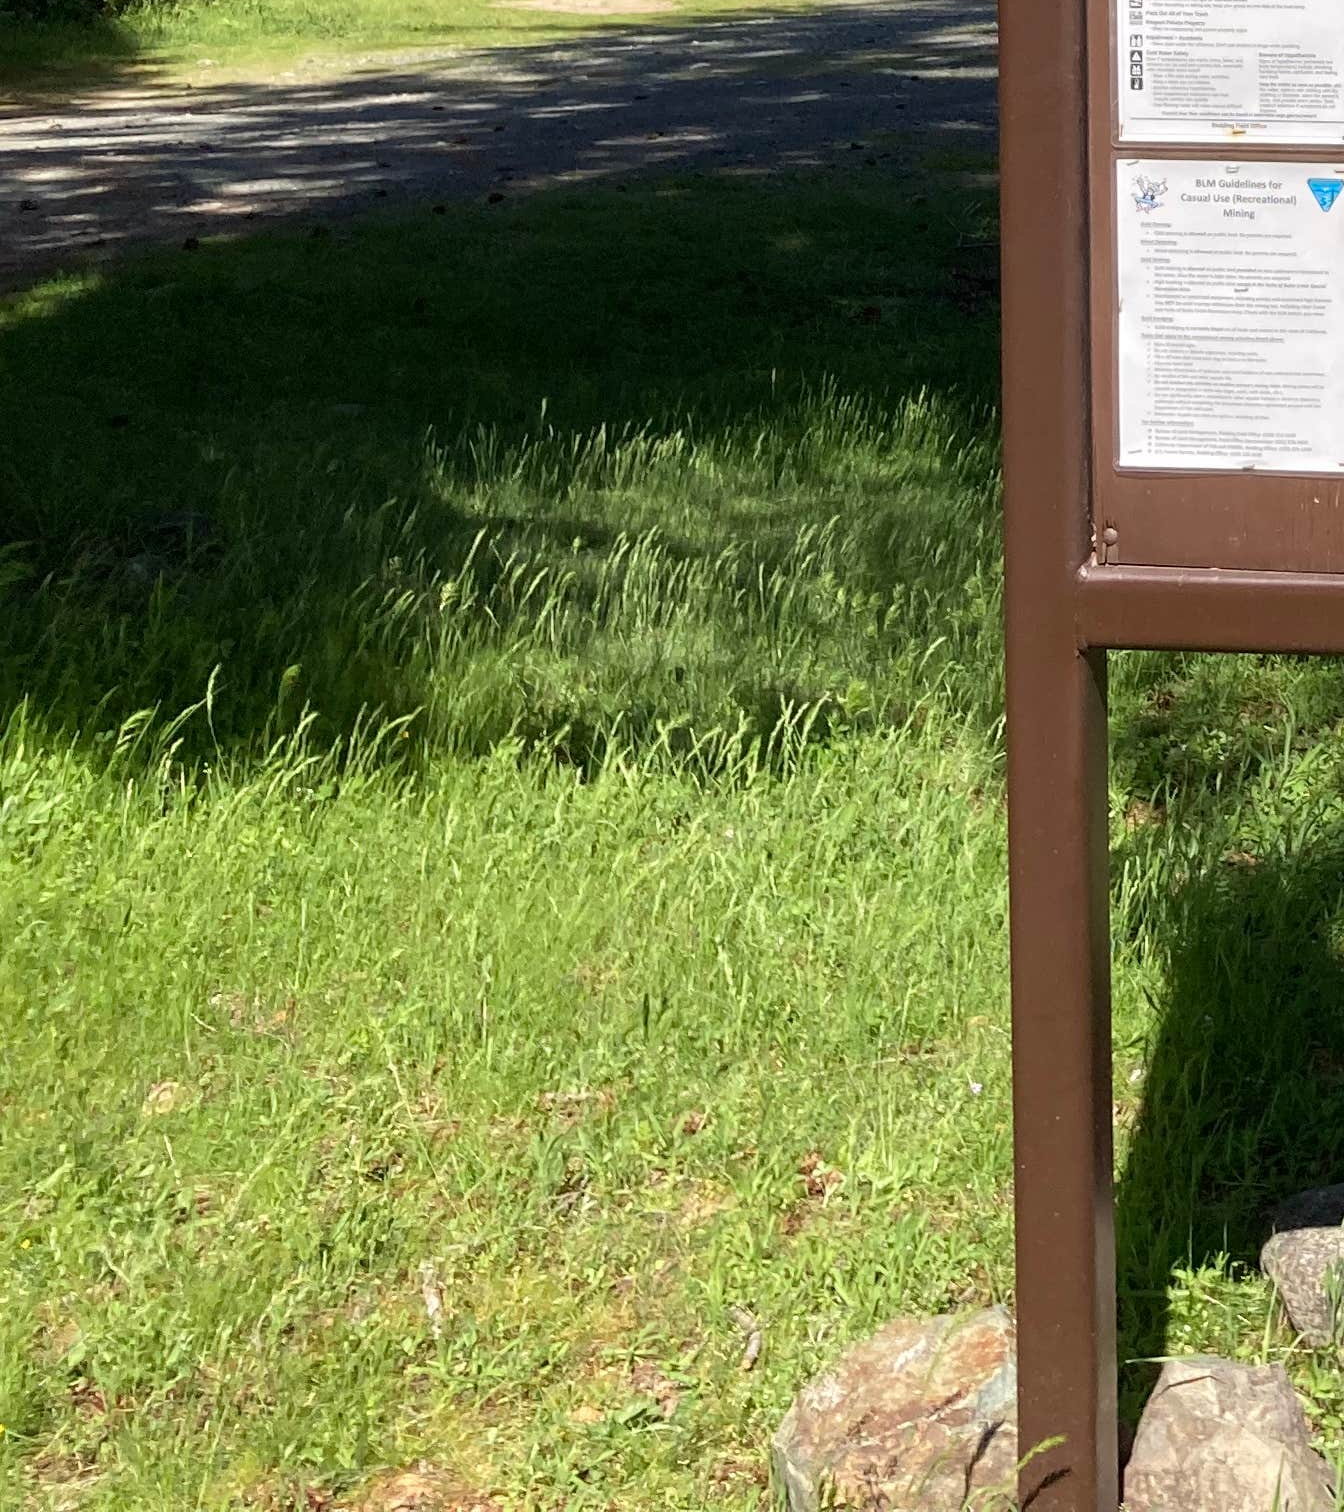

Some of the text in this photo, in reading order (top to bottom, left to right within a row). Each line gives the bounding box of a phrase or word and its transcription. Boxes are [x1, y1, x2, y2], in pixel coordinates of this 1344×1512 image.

[1196, 178, 1282, 189] BLM Guidelines for
[1180, 194, 1297, 206] Casual Use (Recreational)
[1223, 209, 1255, 220] Mining
